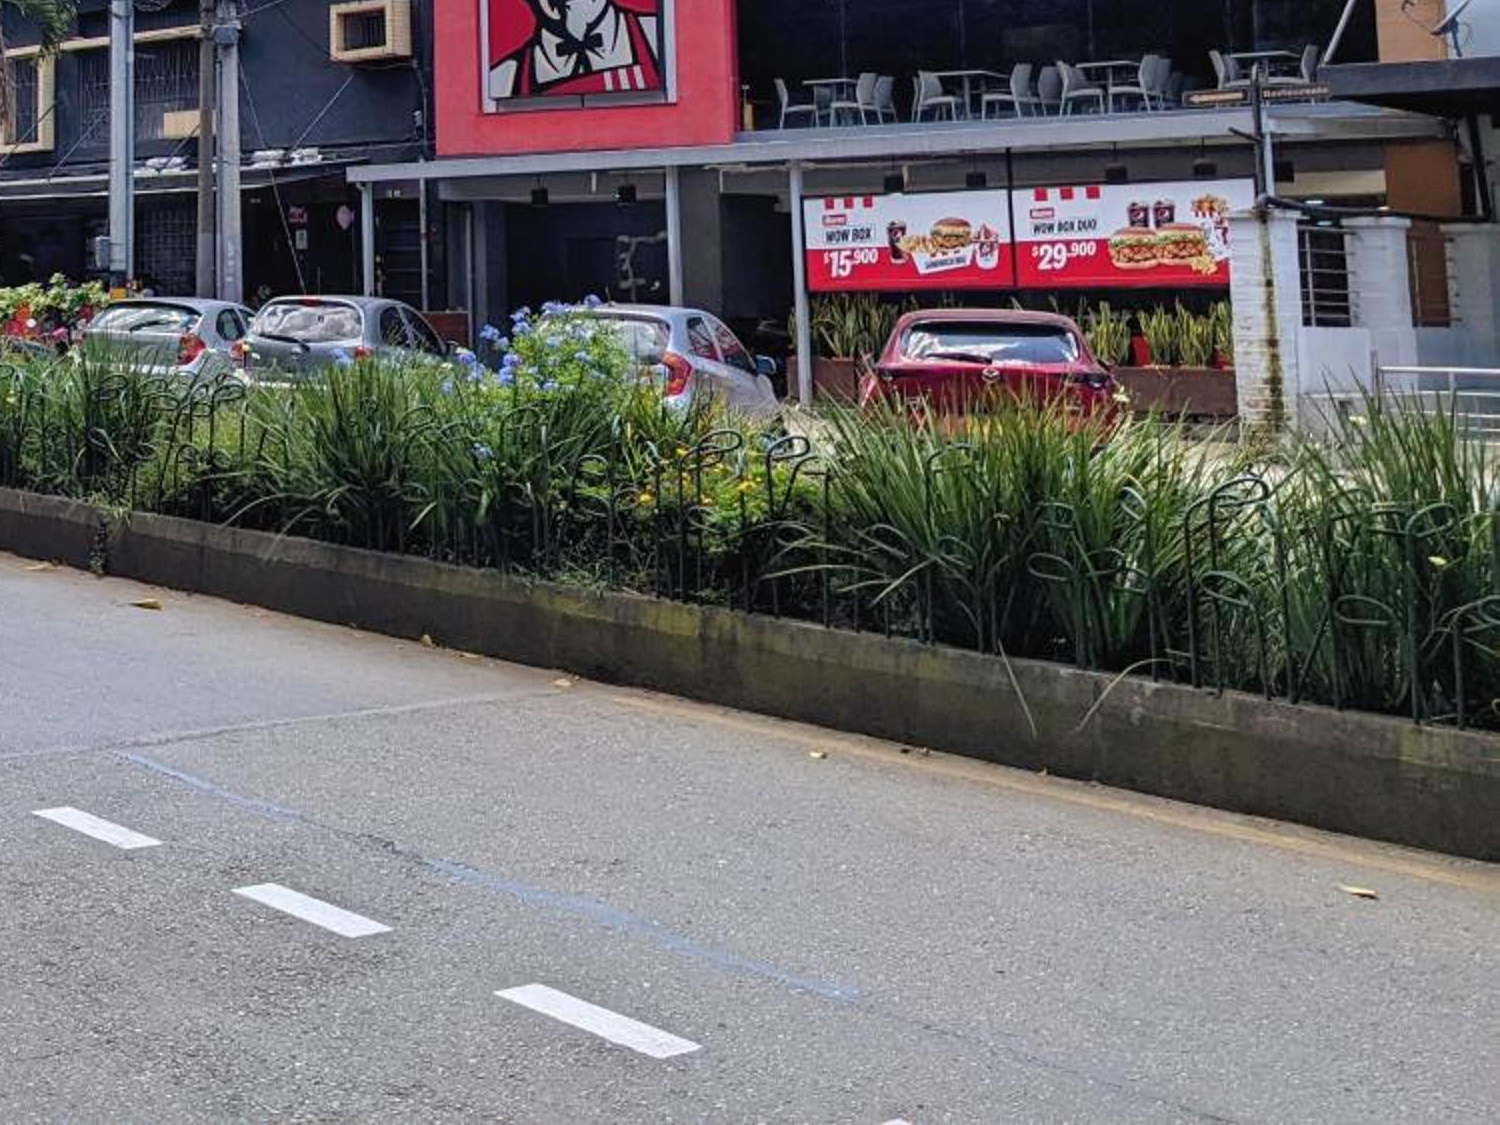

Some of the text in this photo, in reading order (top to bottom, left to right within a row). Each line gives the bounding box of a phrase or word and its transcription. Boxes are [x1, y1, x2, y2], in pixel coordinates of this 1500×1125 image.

[1033, 219, 1097, 234] WOW BOX DUO
[826, 227, 871, 242] WOW BOX
